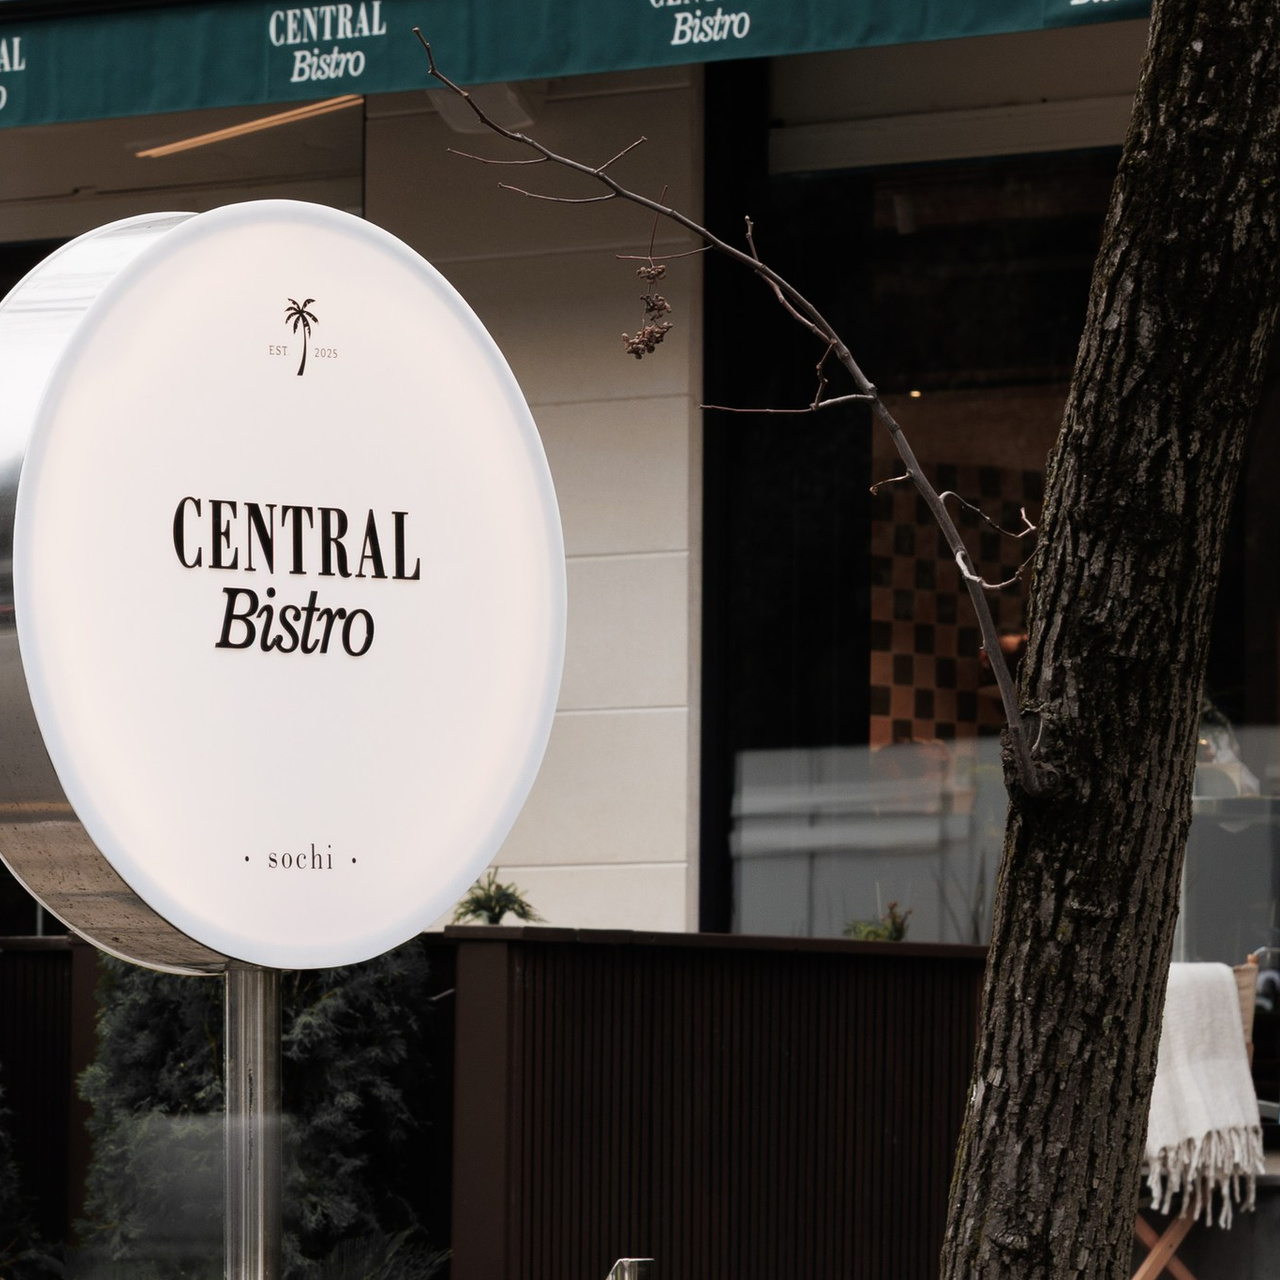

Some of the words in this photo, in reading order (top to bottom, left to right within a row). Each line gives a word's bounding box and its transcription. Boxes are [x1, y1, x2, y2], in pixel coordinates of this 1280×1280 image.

[269, 0, 387, 46] CENTRAL
[670, 7, 751, 46] Bistro
[290, 46, 366, 83] Bistro
[314, 347, 339, 359] 2025
[172, 496, 421, 581] CENTRAL
[214, 587, 375, 657] Bistro
[267, 842, 334, 871] sochi
